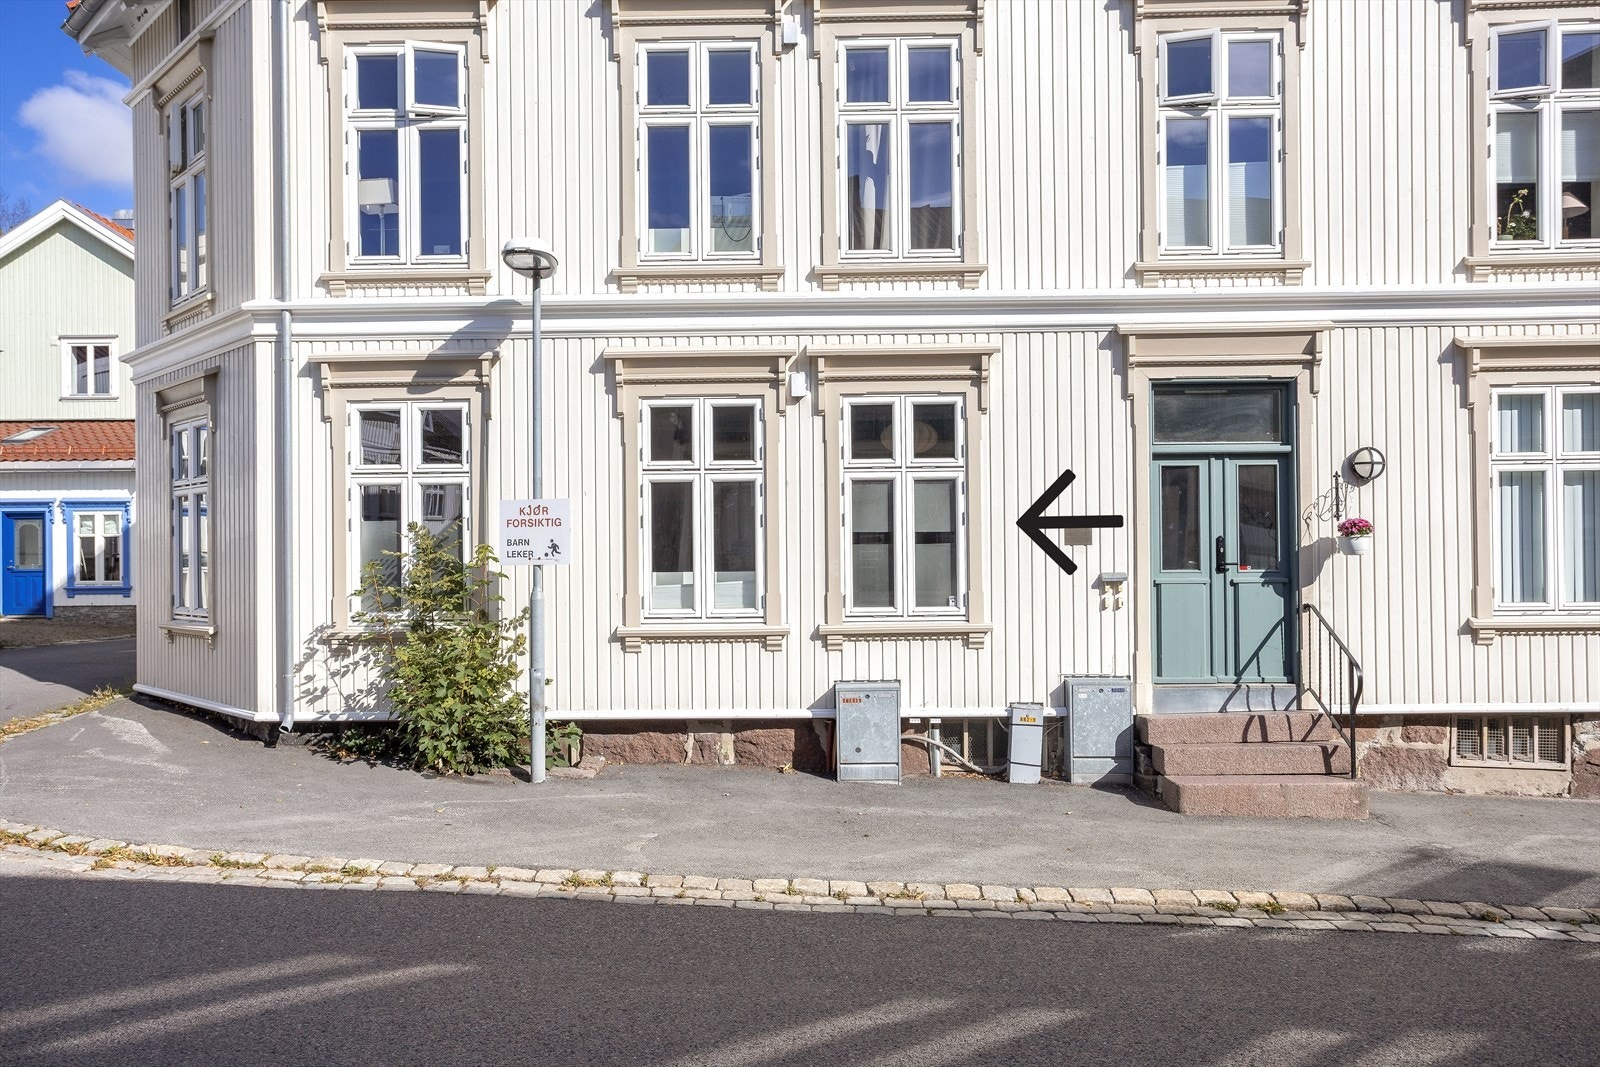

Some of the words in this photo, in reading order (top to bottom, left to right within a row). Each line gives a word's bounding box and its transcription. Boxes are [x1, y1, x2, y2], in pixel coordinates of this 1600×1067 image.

[519, 506, 549, 516] KJØR
[506, 517, 562, 528] FORSIKTIG
[506, 538, 530, 547] BARN
[506, 550, 534, 558] LEKER
